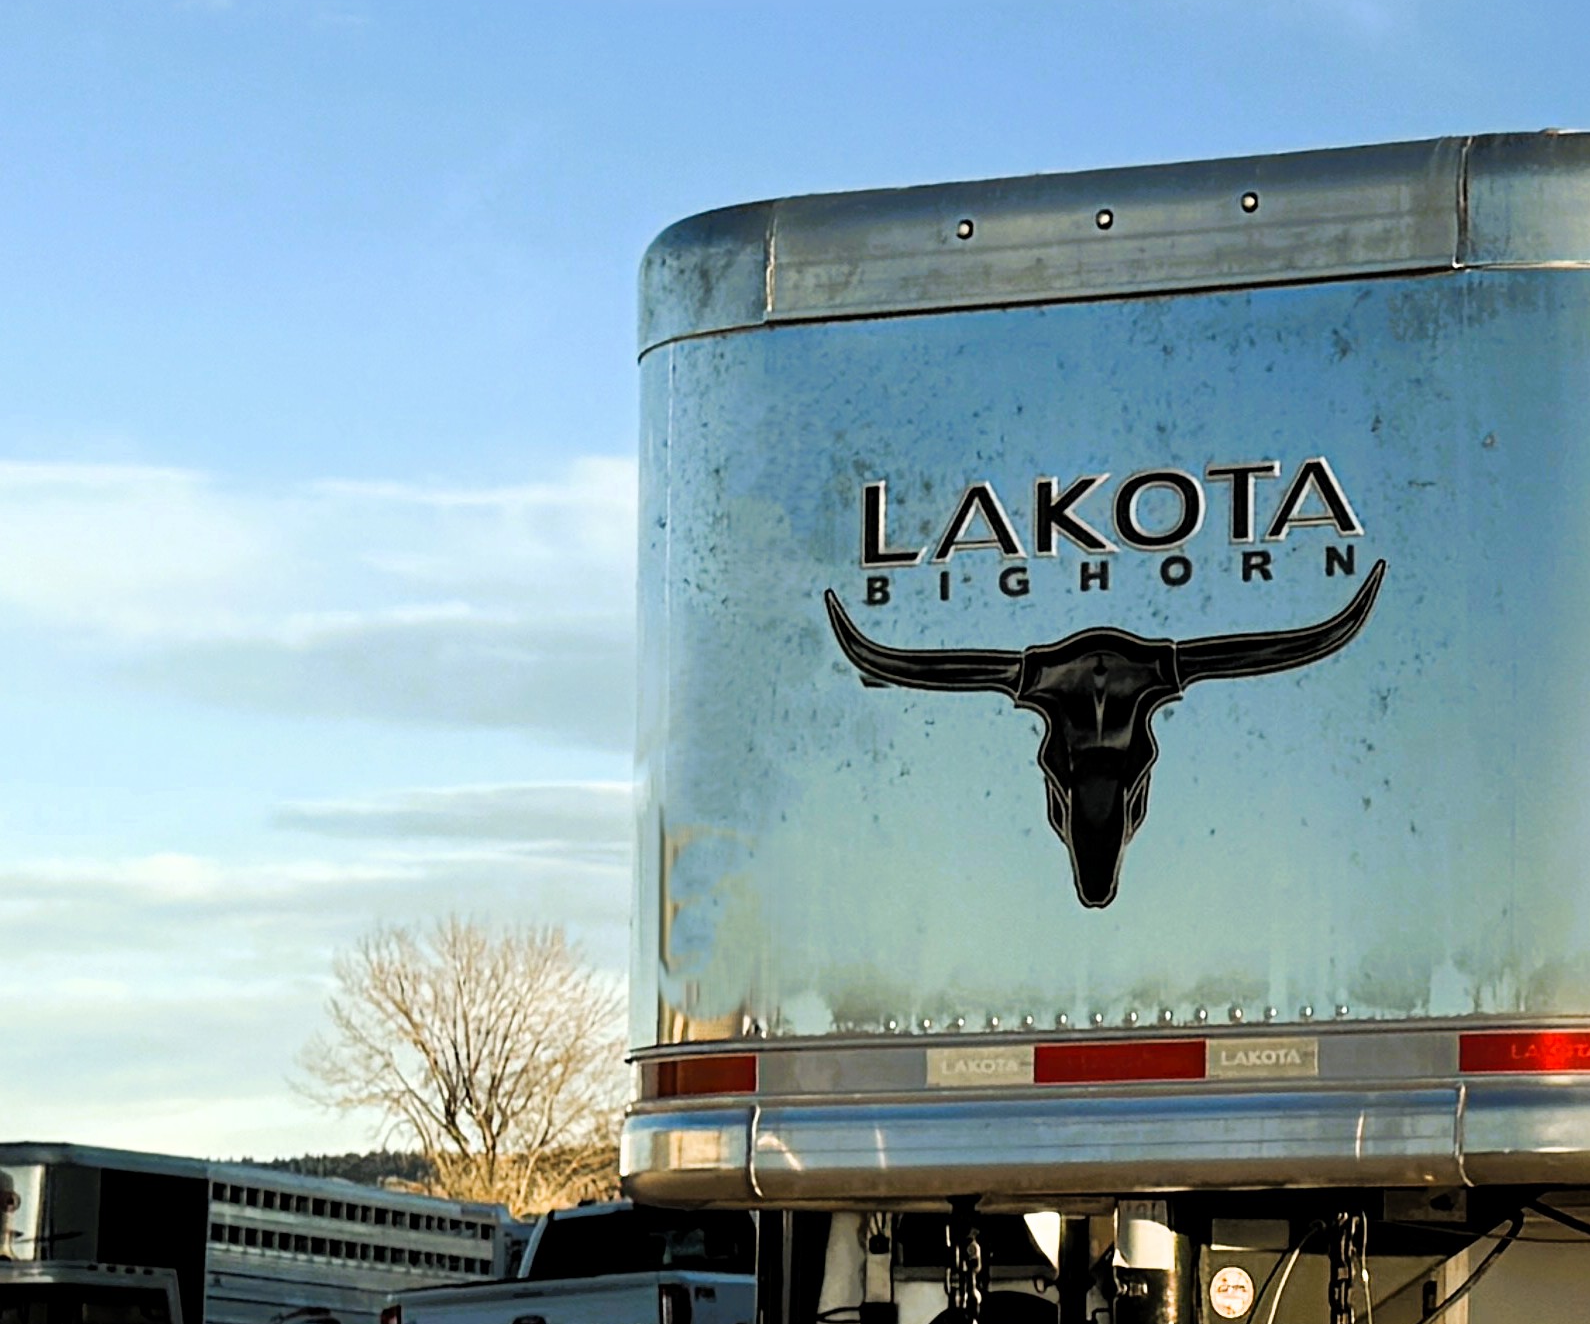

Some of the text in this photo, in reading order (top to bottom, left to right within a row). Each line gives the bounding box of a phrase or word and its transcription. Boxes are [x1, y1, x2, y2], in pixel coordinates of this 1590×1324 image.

[860, 456, 1365, 568] LAKOTA
[865, 545, 1357, 606] BIGHORN
[941, 1058, 1019, 1075] LAKOTA
[1220, 1048, 1302, 1067] LAKOTA
